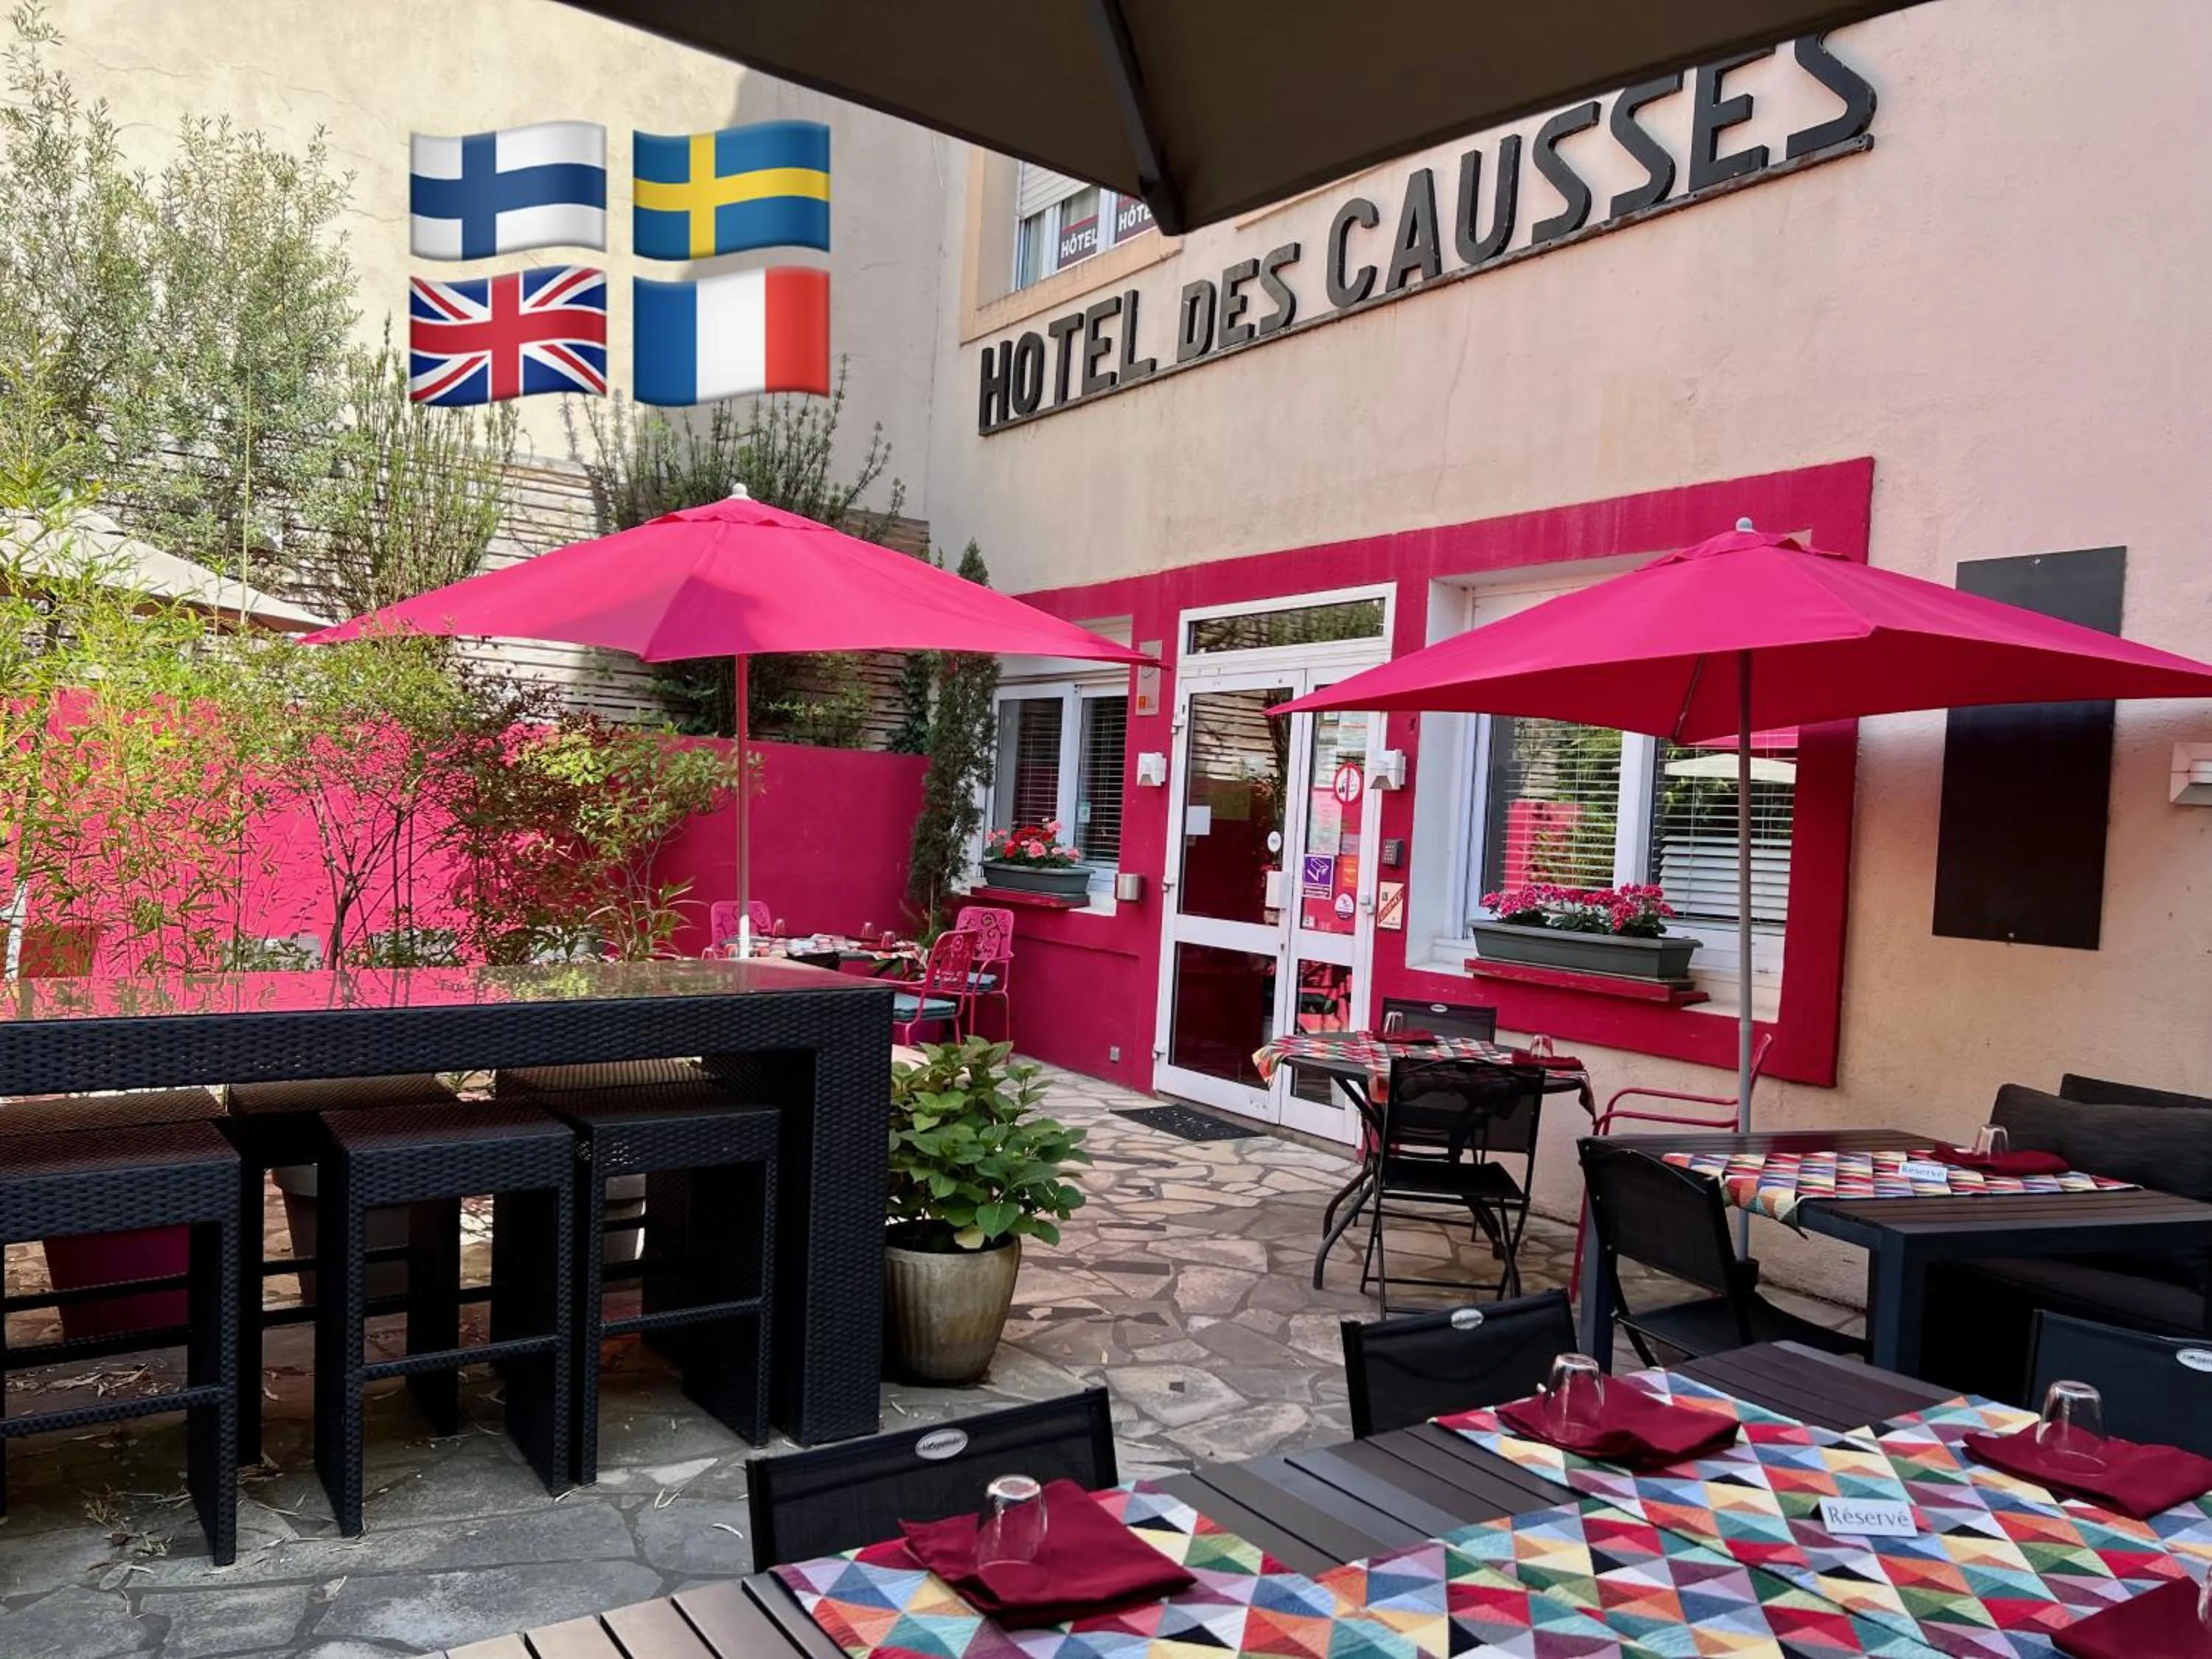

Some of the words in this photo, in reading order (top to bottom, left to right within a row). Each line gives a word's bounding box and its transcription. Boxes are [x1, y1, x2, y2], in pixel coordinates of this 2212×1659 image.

[980, 289, 1157, 428] HOTEL
[1177, 242, 1301, 364] DES
[1326, 33, 1877, 308] CAUSSES
[1118, 203, 1153, 232] HÔTE
[1060, 227, 1098, 259] HÔTEL
[1826, 1504, 1911, 1528] Réservé
